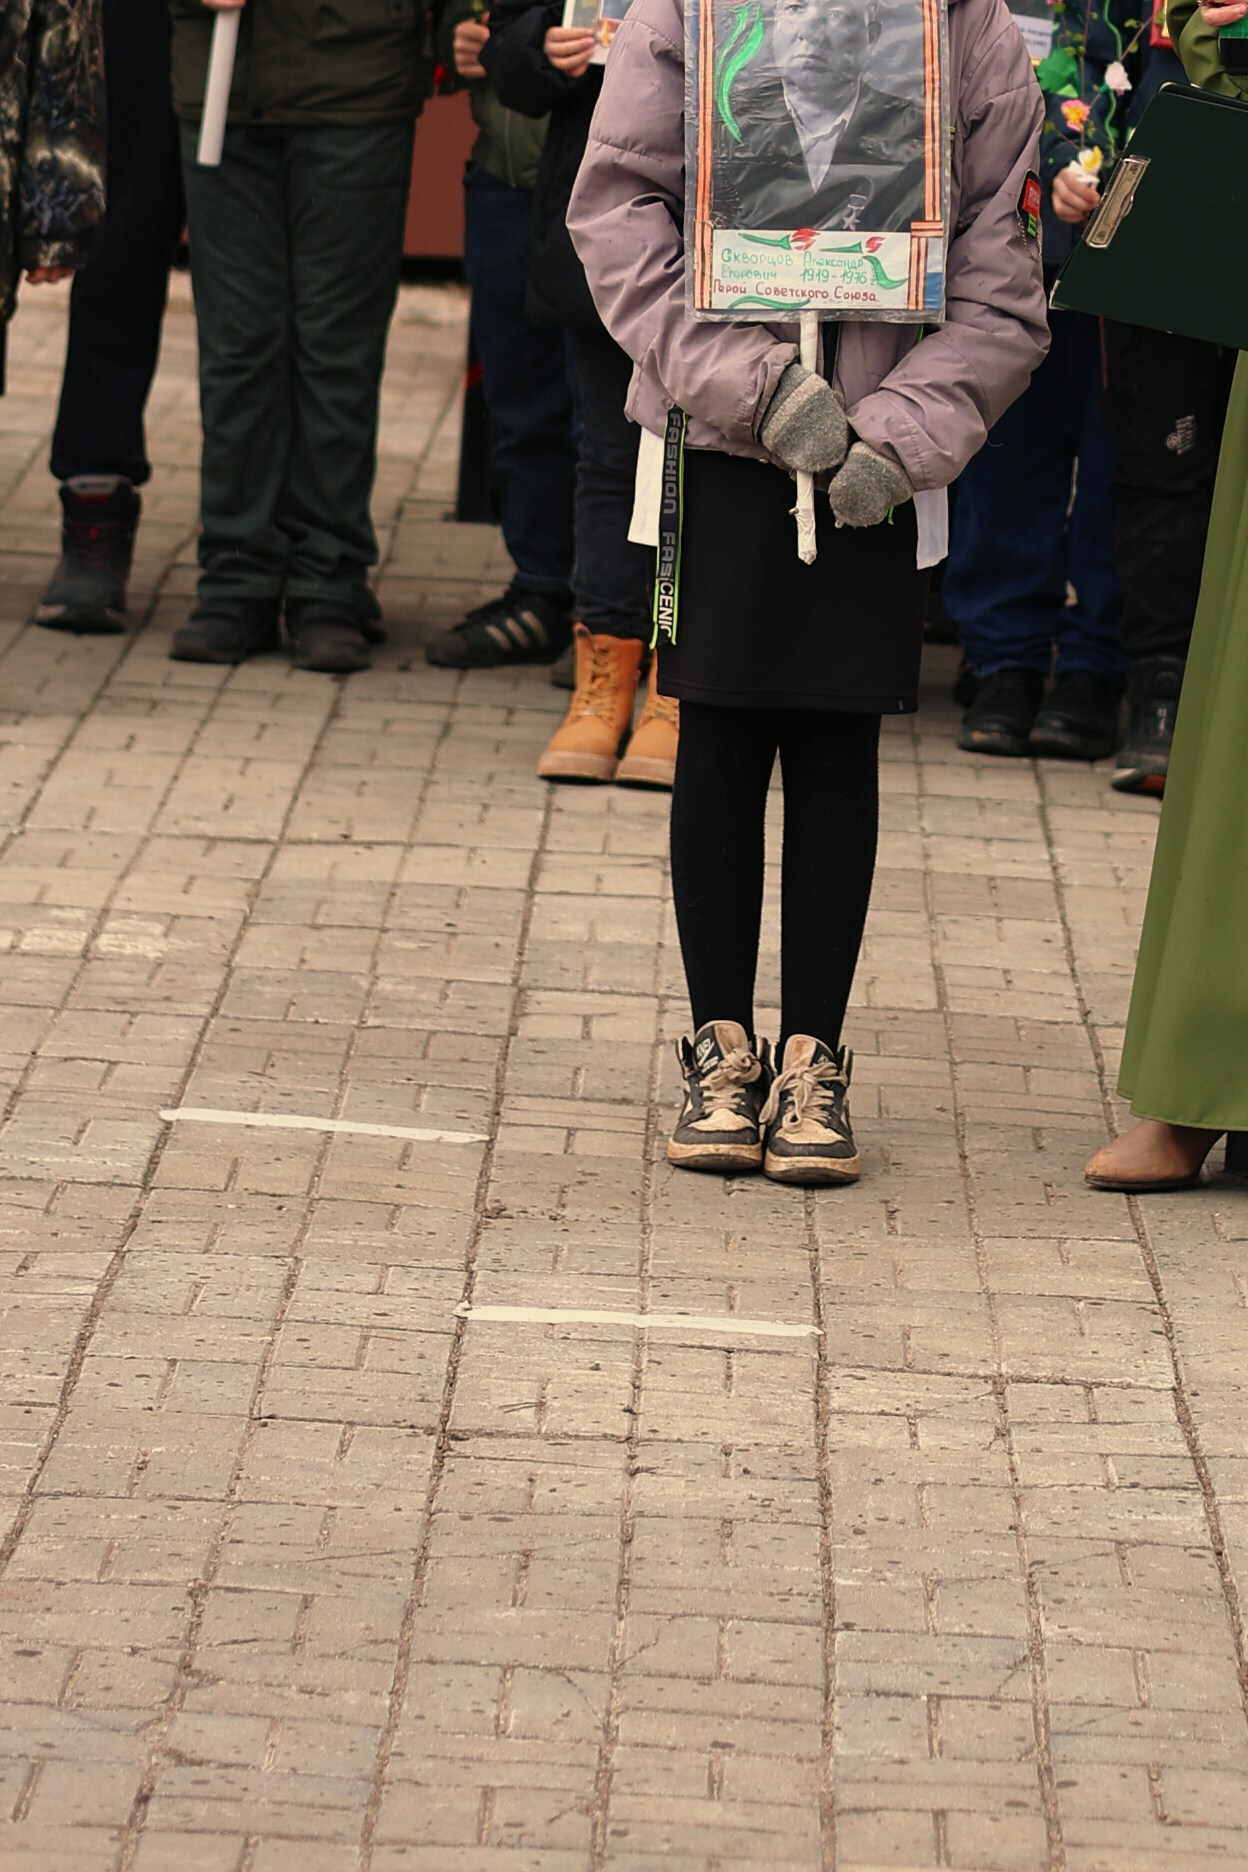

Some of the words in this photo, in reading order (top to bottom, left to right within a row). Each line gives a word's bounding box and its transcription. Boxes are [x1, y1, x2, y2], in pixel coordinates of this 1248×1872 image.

[721, 247, 793, 267] Скворцов
[713, 278, 747, 295] Герой
[756, 281, 829, 300] Советского
[834, 283, 877, 302] Союза
[663, 412, 680, 515] FASHION
